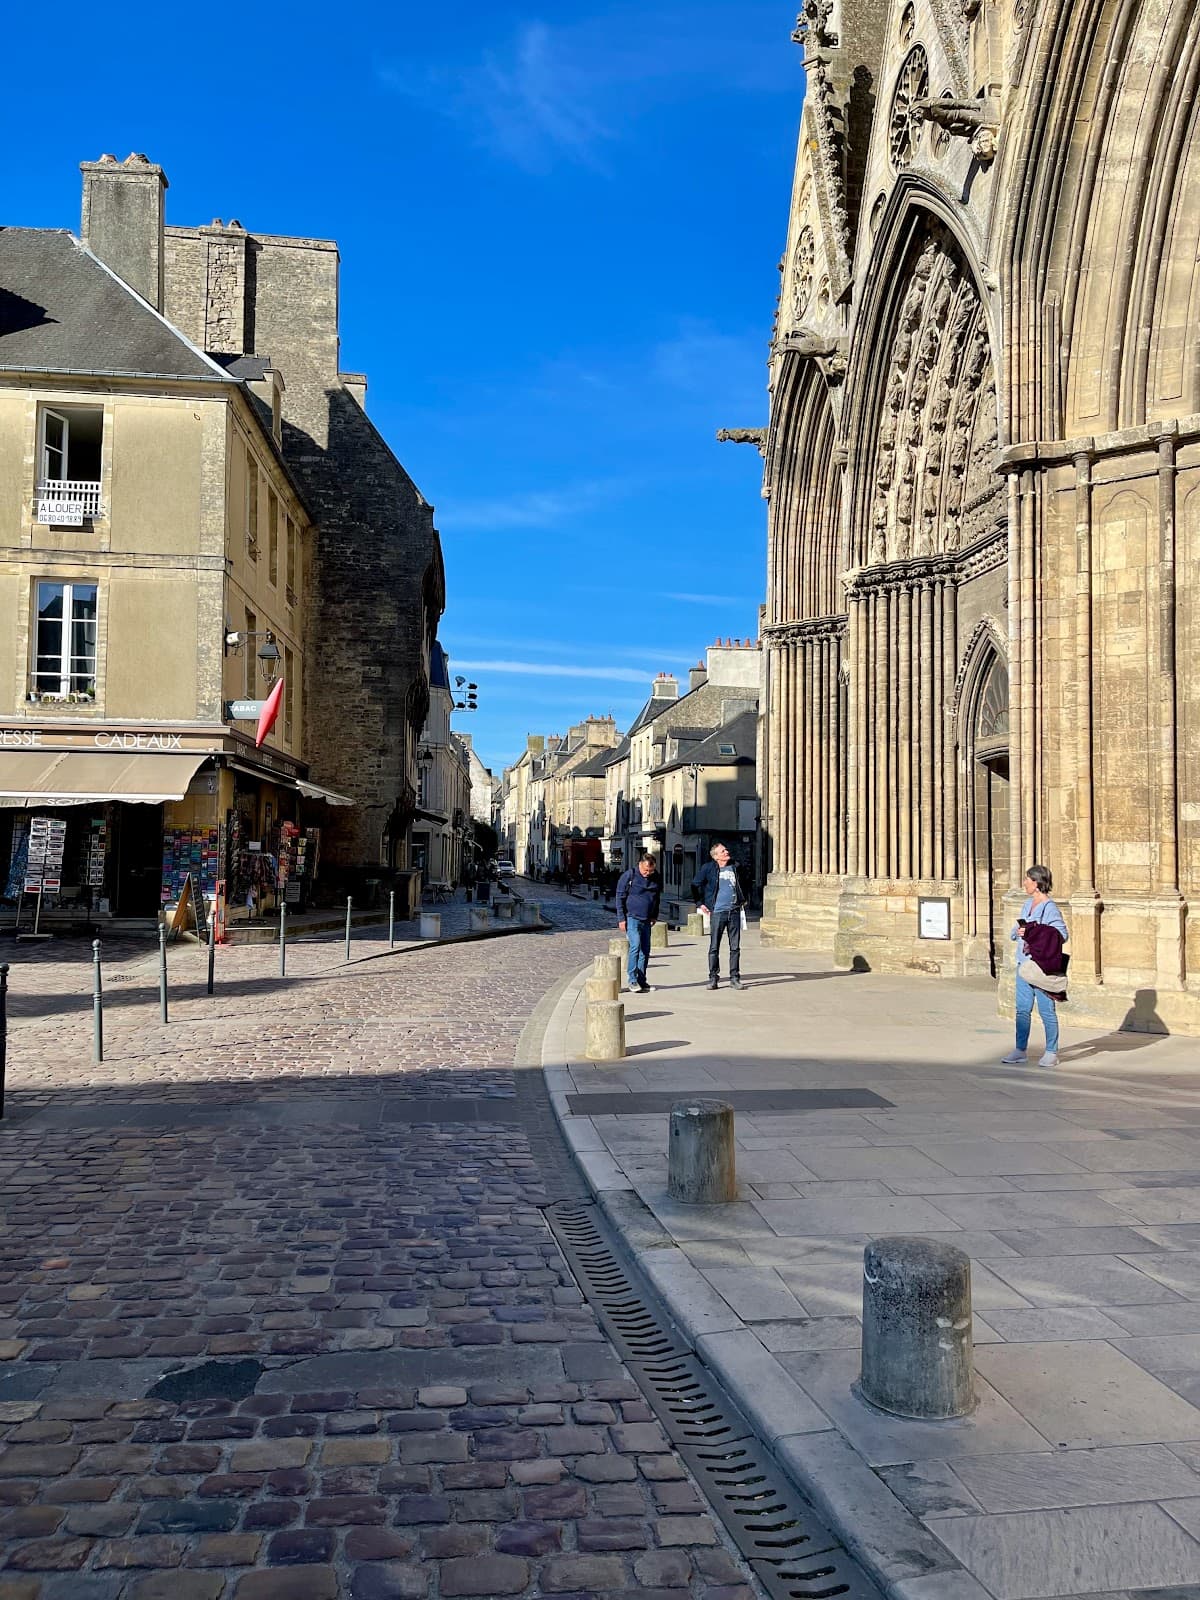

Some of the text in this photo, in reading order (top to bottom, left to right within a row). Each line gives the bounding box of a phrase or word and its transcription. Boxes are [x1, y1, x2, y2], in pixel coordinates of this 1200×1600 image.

[40, 504, 82, 513] A LOUER
[94, 732, 182, 748] CADEAUX
